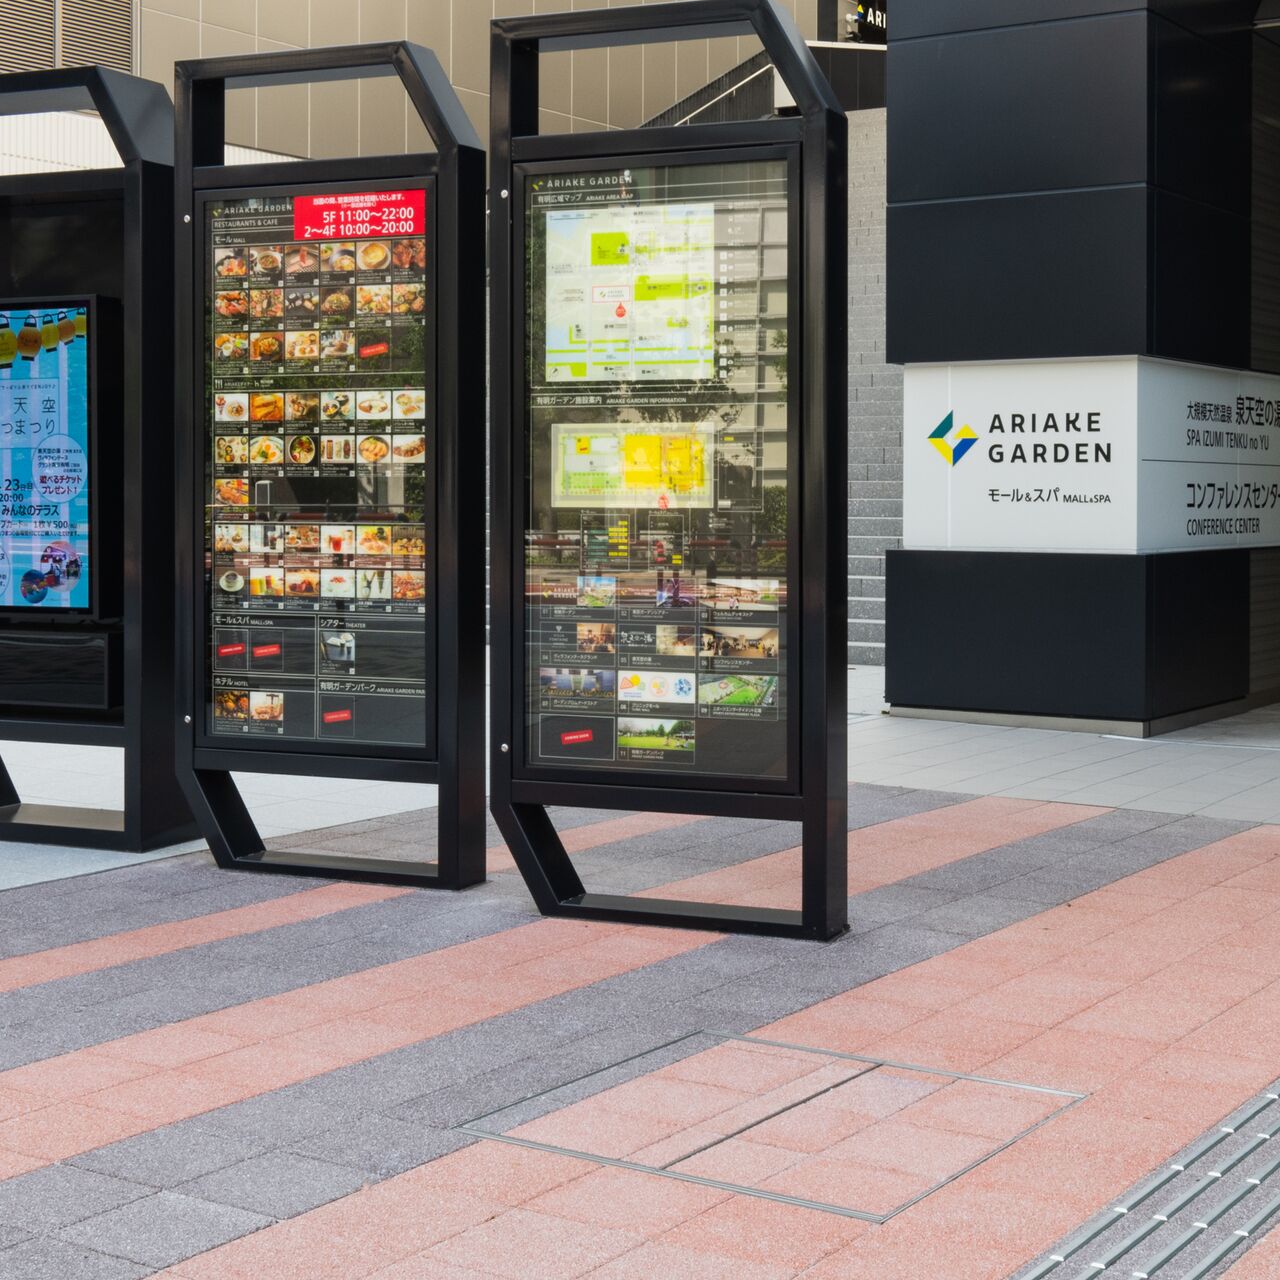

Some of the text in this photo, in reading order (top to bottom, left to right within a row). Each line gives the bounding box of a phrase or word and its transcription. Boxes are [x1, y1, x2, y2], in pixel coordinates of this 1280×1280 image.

[547, 179, 586, 188] ARIAKE
[224, 205, 293, 215] ARIAKE GARDEN
[323, 211, 336, 224] 5F
[214, 220, 257, 228] RESTAURANTS
[215, 235, 233, 244] モール
[1187, 400, 1232, 424] 大規模天然温泉
[988, 412, 1101, 433] ARIAKE
[1187, 429, 1270, 450] SPA IZUMI TENKU no YU
[988, 442, 1111, 463] GARDEN
[0, 493, 23, 503] 20:00
[988, 487, 1111, 504] モール&スパ MALL&SPA
[1, 505, 60, 516] みんなのテラス
[1187, 517, 1260, 536] CONFERENCE CENTER
[320, 619, 345, 628] シアター
[215, 677, 233, 686] ホテル
[320, 682, 376, 692] 有明ガーデンパーク
